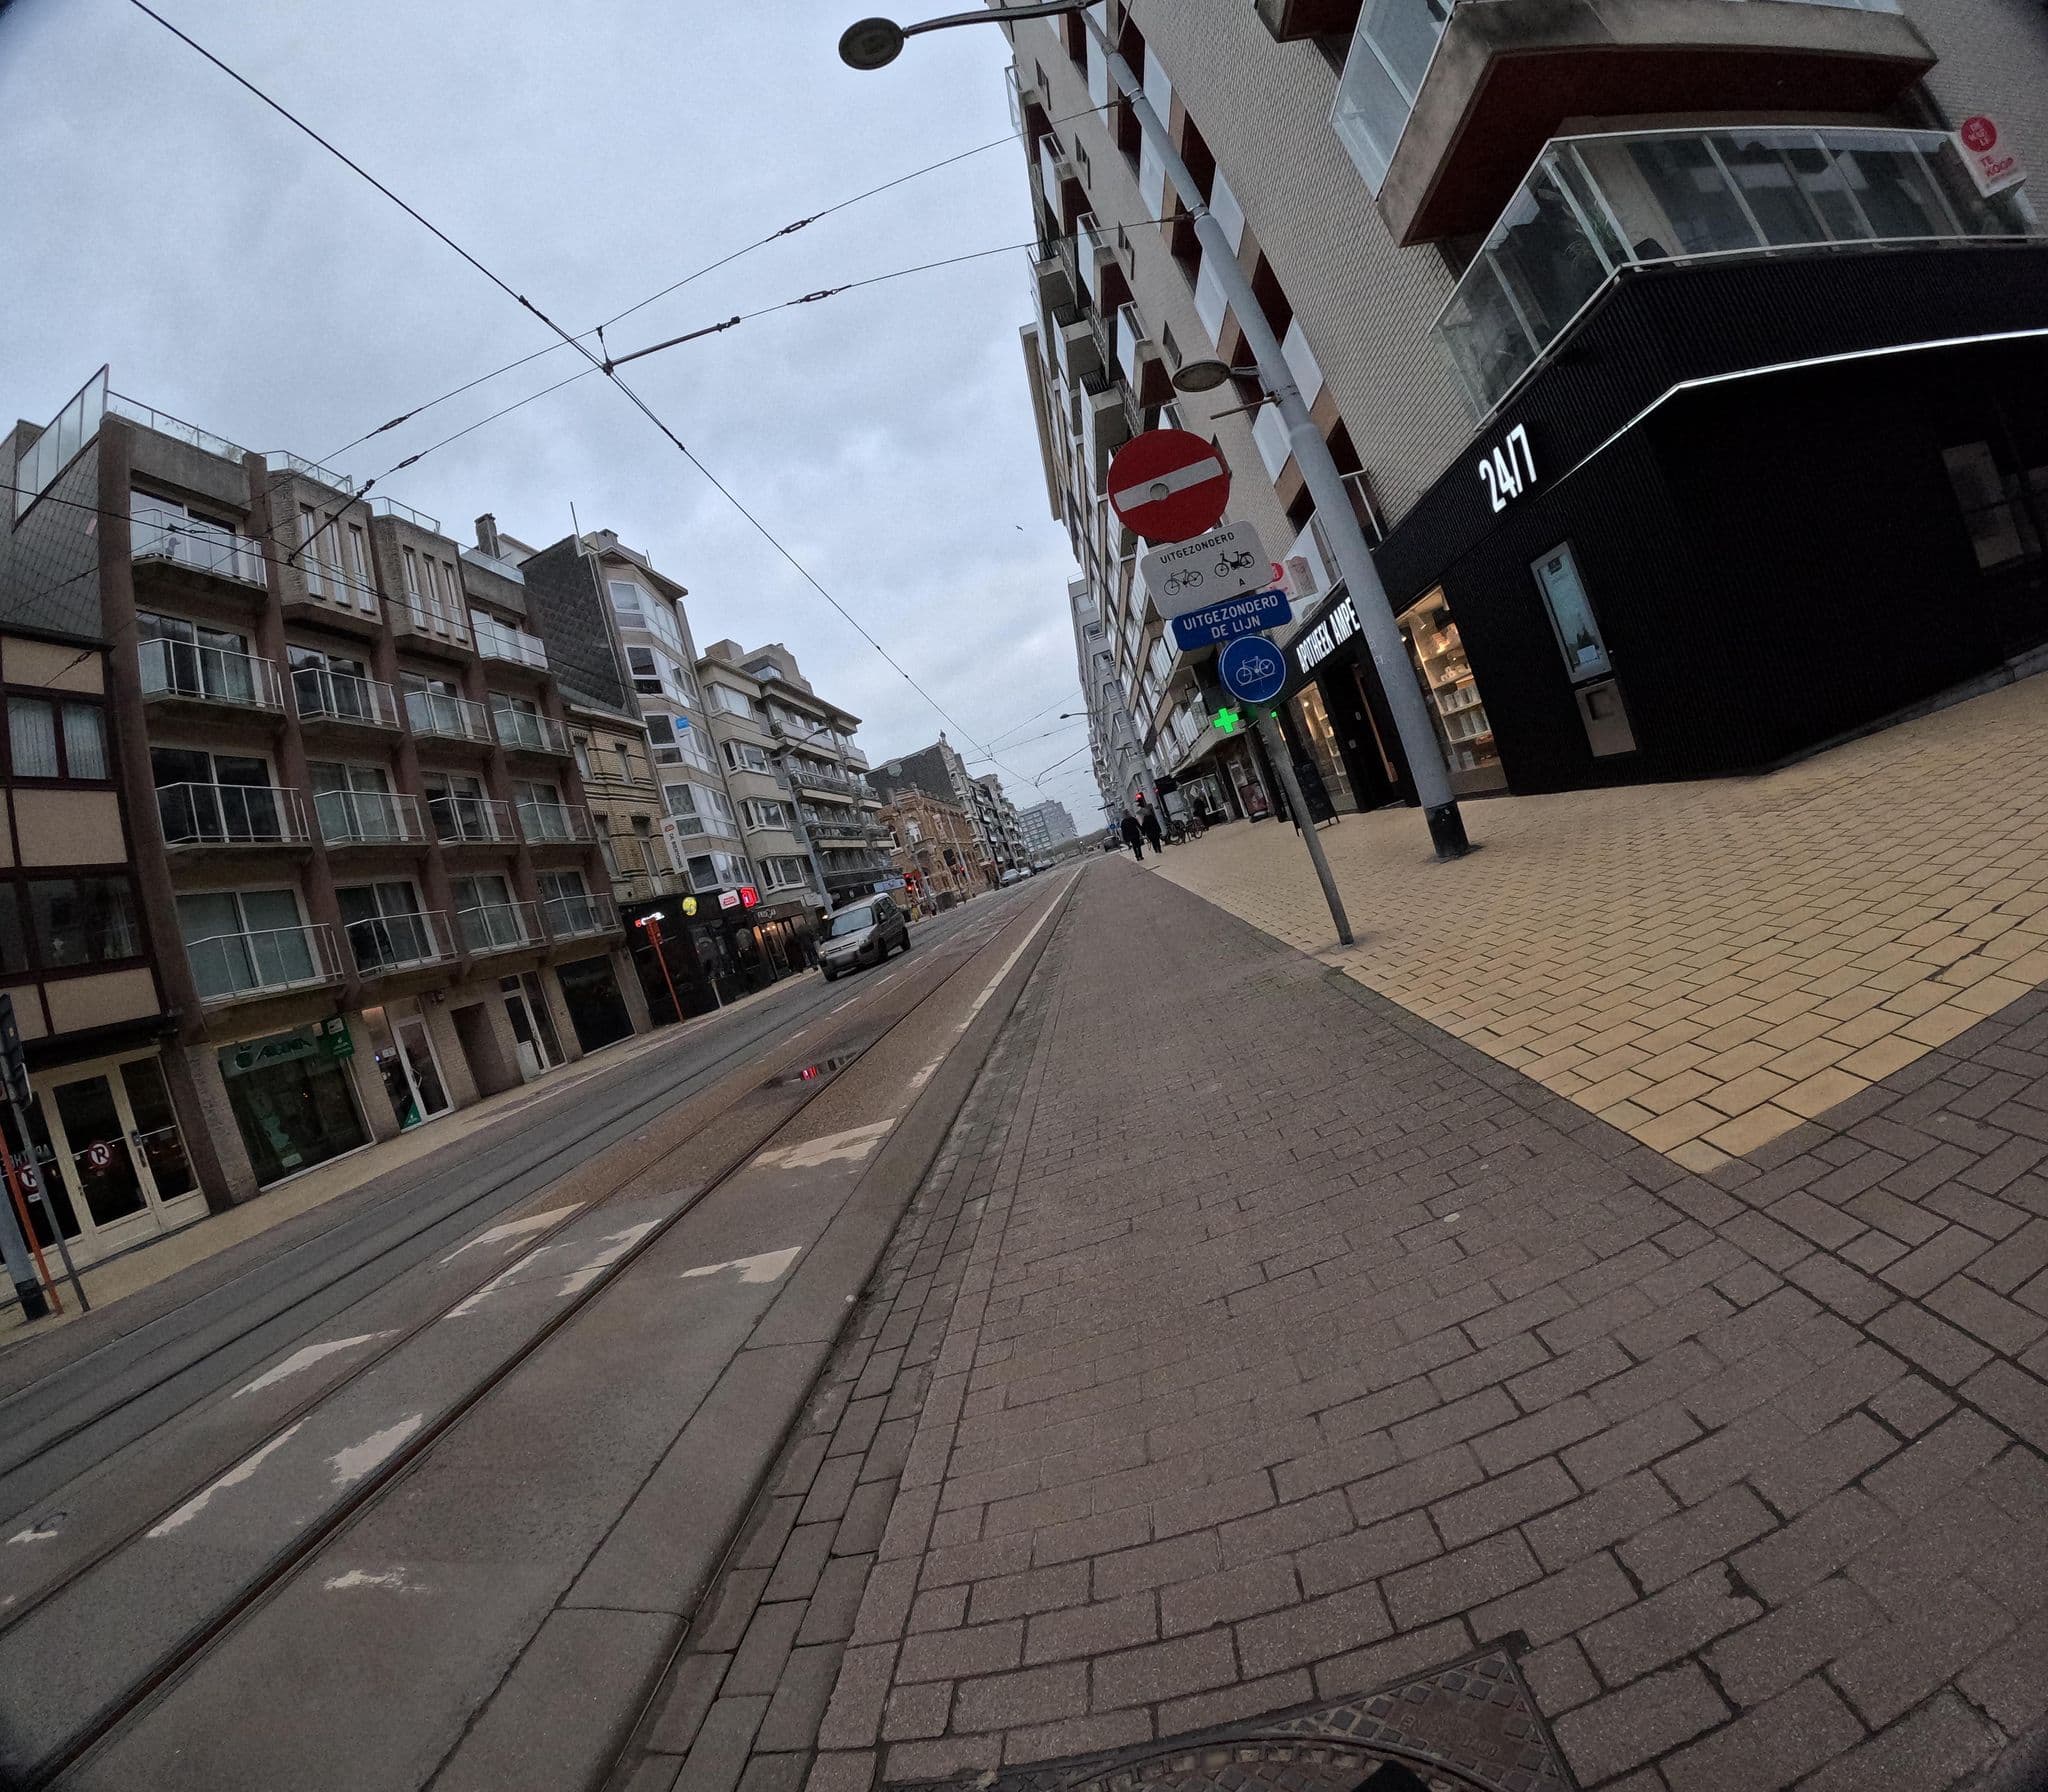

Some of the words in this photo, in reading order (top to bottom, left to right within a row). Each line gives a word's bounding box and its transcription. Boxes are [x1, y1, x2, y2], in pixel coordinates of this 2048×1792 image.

[1478, 422, 1537, 513] 24/7
[1160, 531, 1235, 564] UITGEZONDERD
[1239, 578, 1246, 586] A
[1183, 595, 1279, 631] UITGEZONDERD
[1211, 624, 1229, 639] DE
[1232, 615, 1261, 633] LIJN
[1296, 620, 1336, 674] APOTHEEK
[1329, 596, 1360, 646] AMPE
